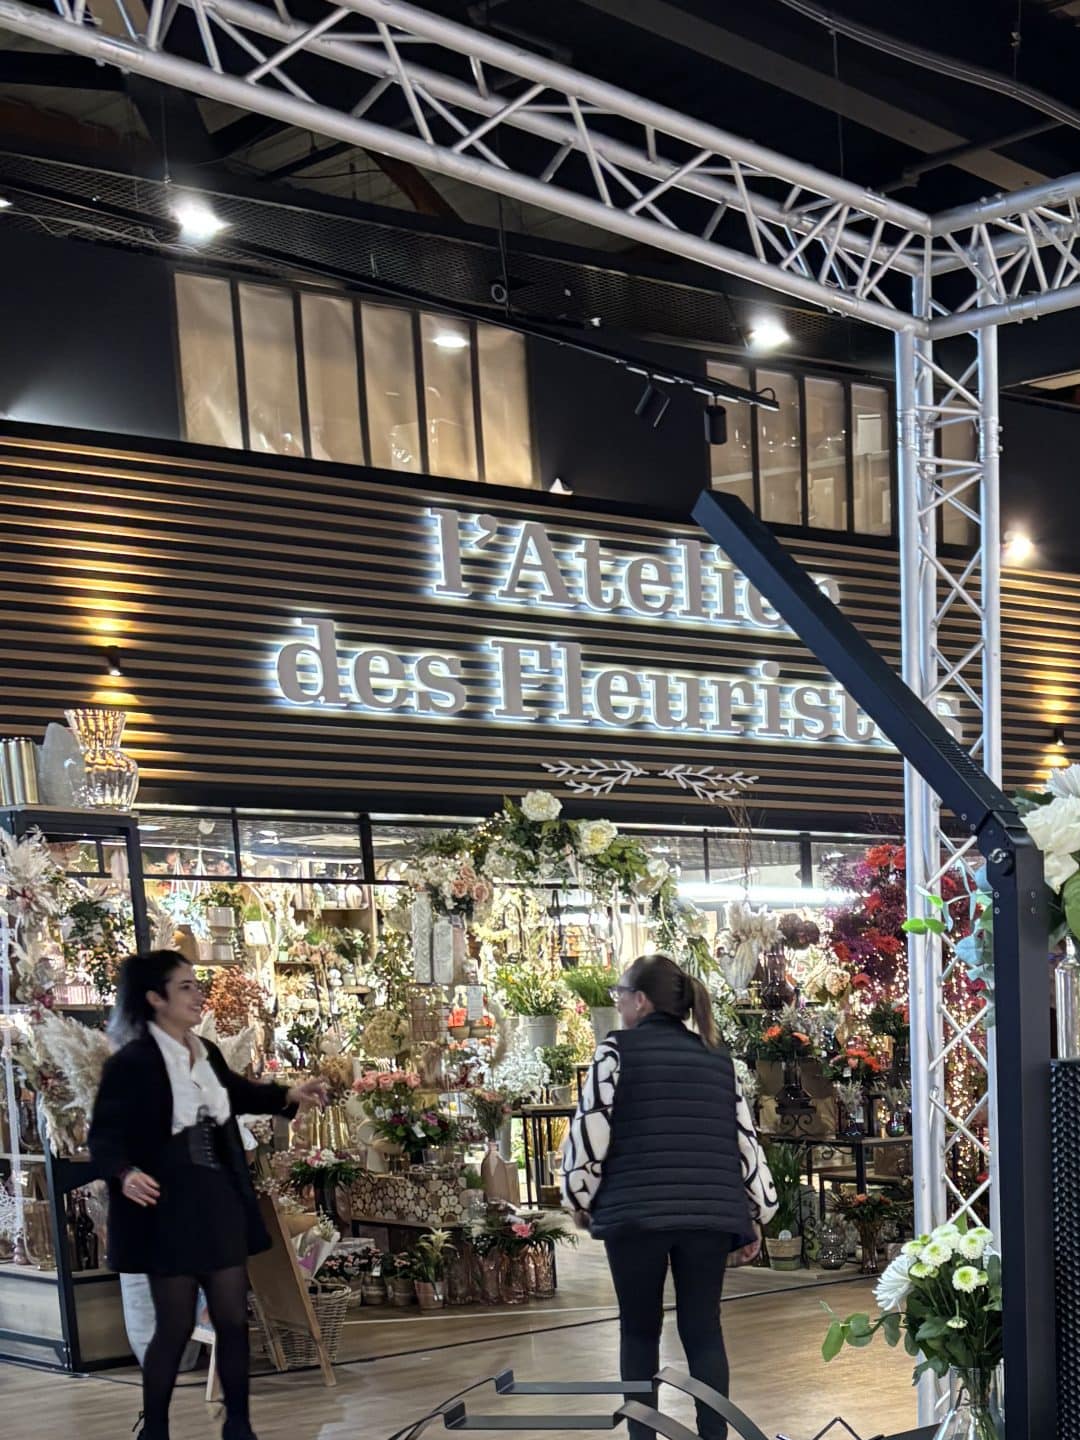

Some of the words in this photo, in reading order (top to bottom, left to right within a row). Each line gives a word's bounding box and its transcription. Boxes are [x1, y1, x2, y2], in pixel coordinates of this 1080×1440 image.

[429, 507, 841, 628] l'Ateli
[277, 616, 468, 716] des
[492, 636, 963, 745] Fleurist
